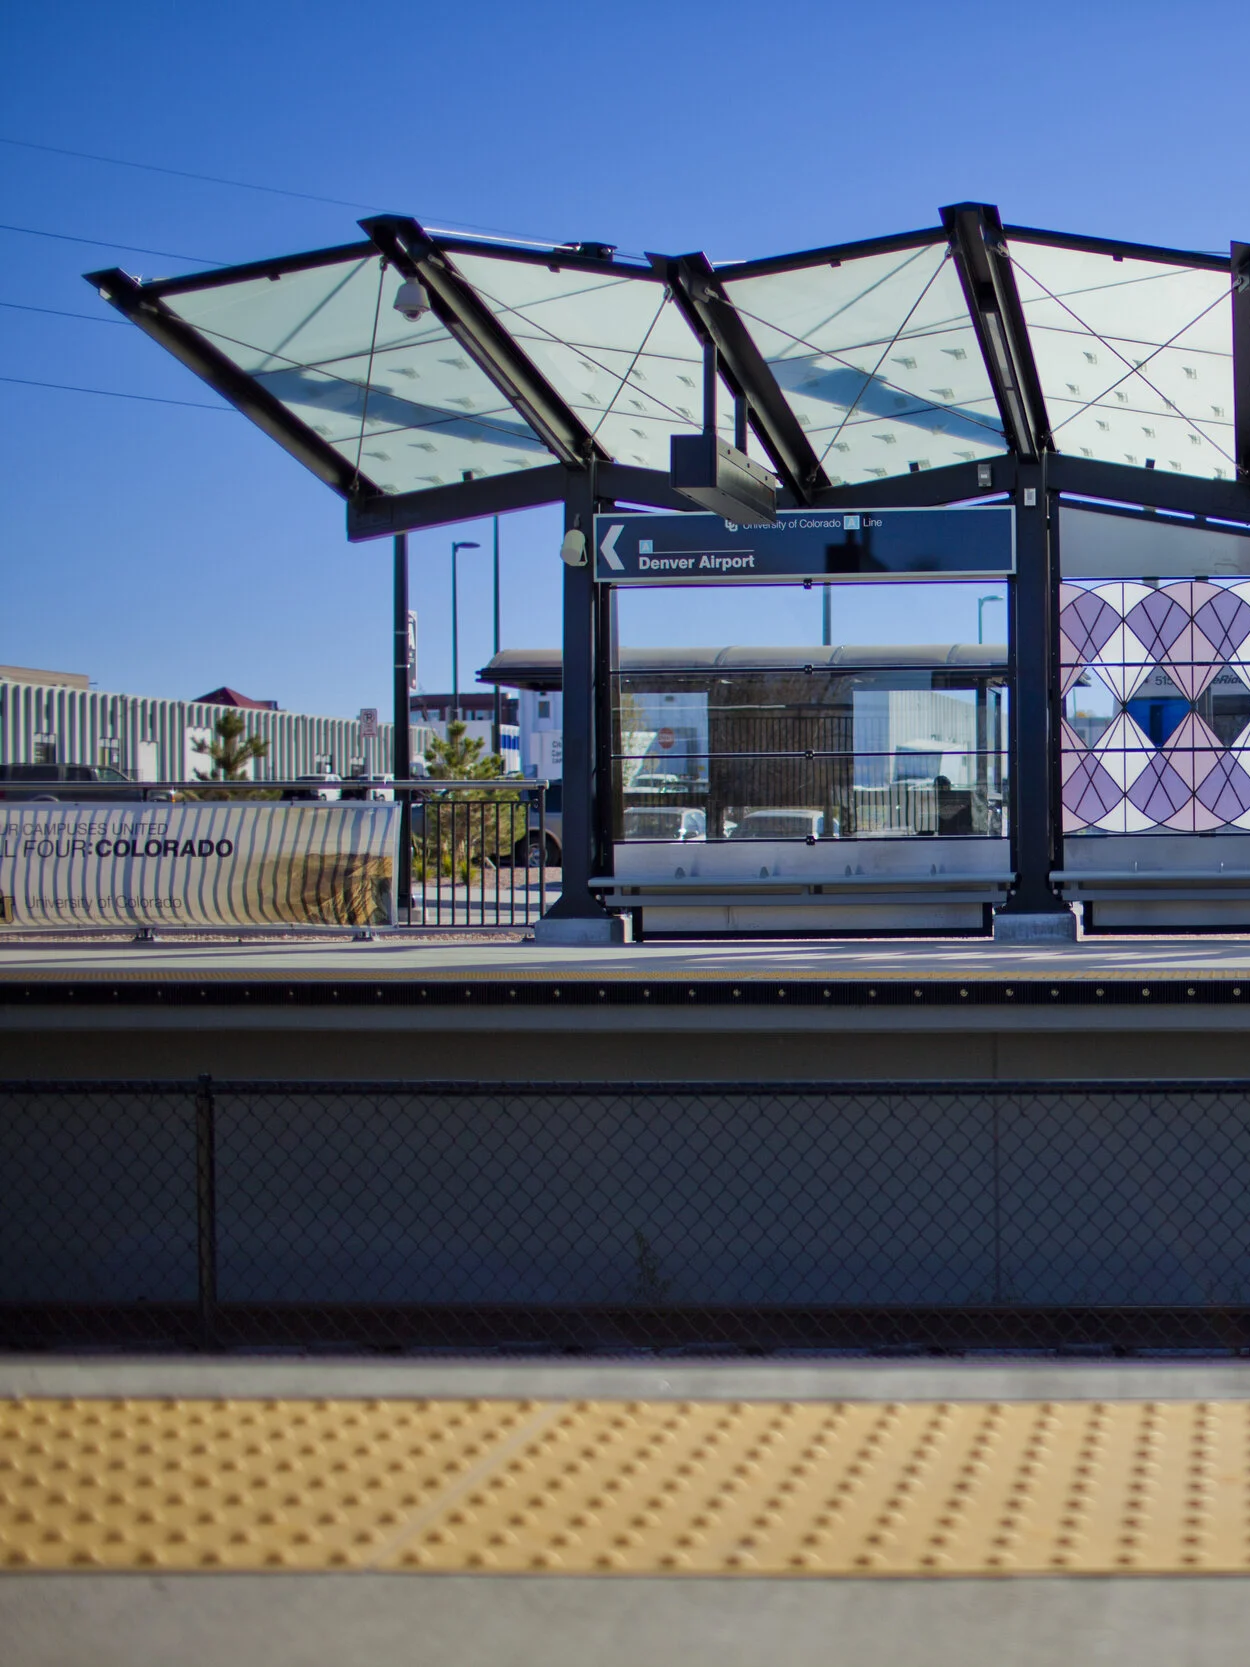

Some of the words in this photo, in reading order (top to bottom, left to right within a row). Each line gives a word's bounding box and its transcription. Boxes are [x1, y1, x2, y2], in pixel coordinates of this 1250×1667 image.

[788, 519, 798, 529] of
[799, 518, 841, 529] Colorado
[863, 517, 883, 527] Line
[639, 556, 695, 570] Denver
[699, 555, 755, 571] Airport
[23, 823, 107, 836] CAMPUSES
[112, 823, 168, 836] UNITED
[23, 839, 233, 858] FOUR:COLORADO
[25, 895, 93, 912] University
[98, 895, 112, 909] of
[114, 895, 182, 909] Colorado
